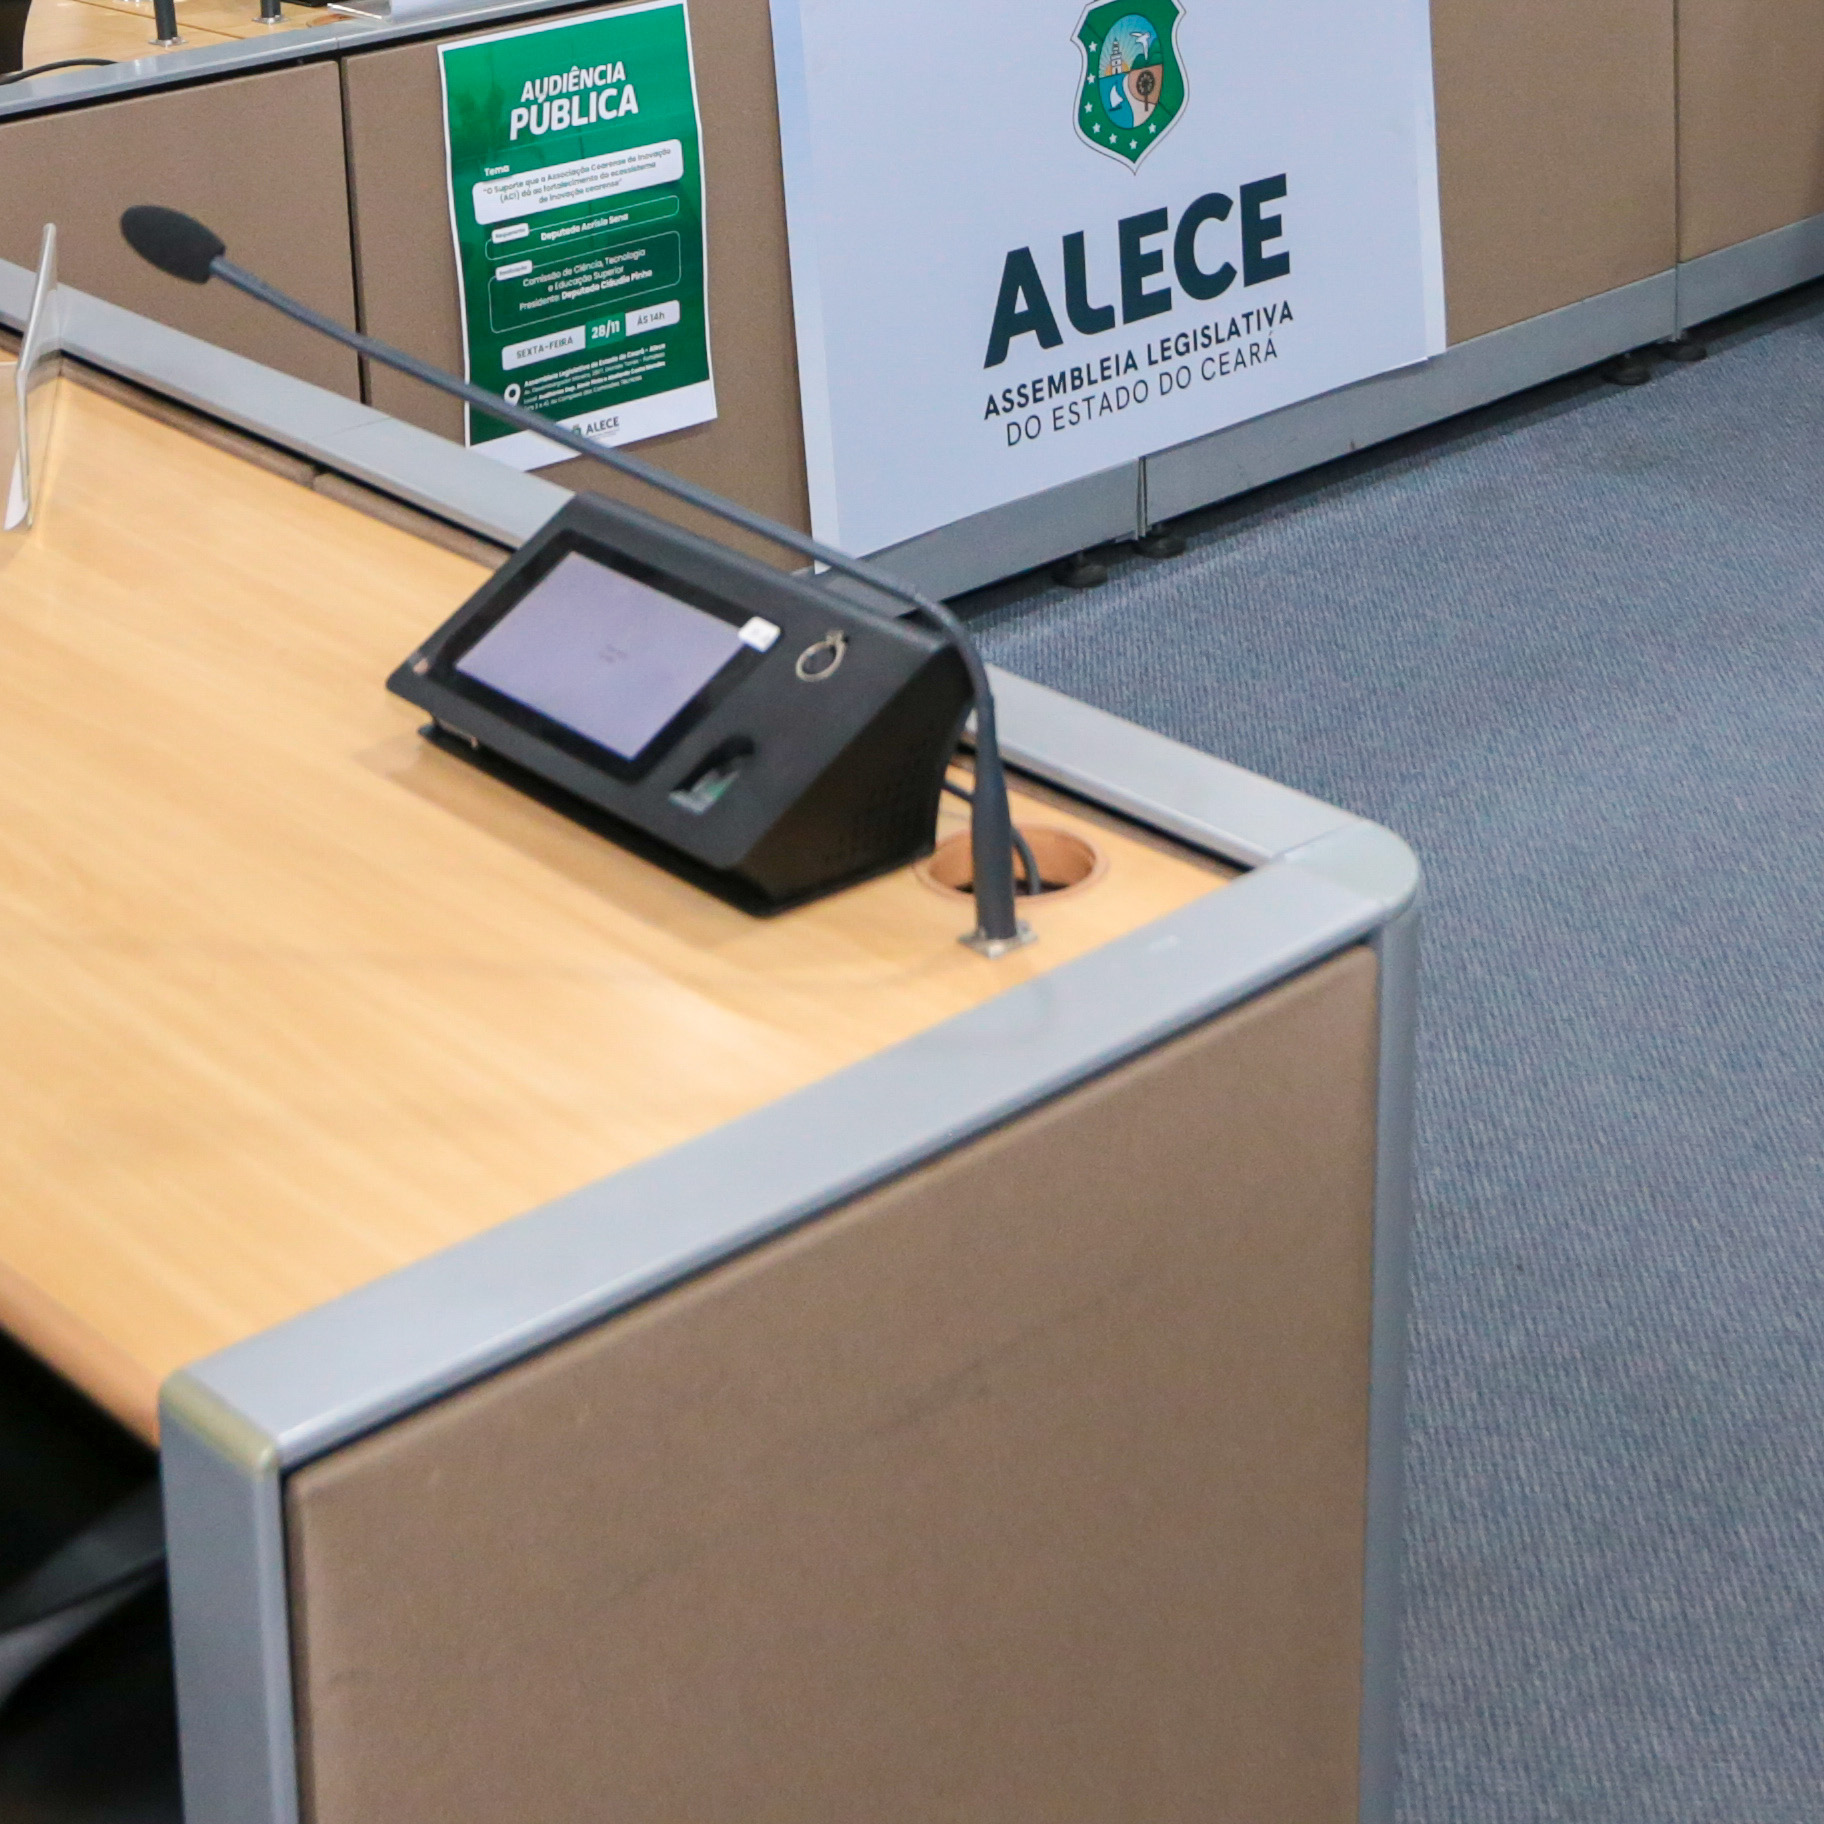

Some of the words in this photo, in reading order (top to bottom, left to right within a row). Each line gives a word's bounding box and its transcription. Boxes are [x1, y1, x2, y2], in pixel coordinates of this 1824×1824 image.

[520, 61, 626, 104] AUDIÊNCIA
[509, 84, 639, 141] PÚBLICA
[484, 165, 510, 176] Tema
[494, 181, 524, 193] Suporte
[525, 178, 539, 188] que
[547, 166, 590, 181] Associação
[543, 174, 599, 193] fortalecimento
[540, 225, 581, 241] Deputado
[609, 213, 629, 224] Sena
[522, 270, 562, 287] Comissão
[562, 268, 573, 276] de
[604, 249, 646, 265] Tecnologia
[554, 274, 592, 292] Educação
[593, 265, 624, 280] Superior
[983, 172, 1290, 369] ALECE
[561, 283, 600, 300] Deputado
[516, 336, 574, 359] SEXTA-FEIRA
[591, 320, 621, 339] 28/11
[649, 311, 665, 323] 14h
[984, 350, 1138, 420] ASSEMBLEIA
[1147, 300, 1294, 366] LEGISLATIVA
[1006, 415, 1042, 447] DO
[1052, 379, 1149, 432] ESTADO
[1159, 365, 1192, 396] DO
[1201, 330, 1278, 384] CEARÁ
[586, 416, 620, 434] ALECE
